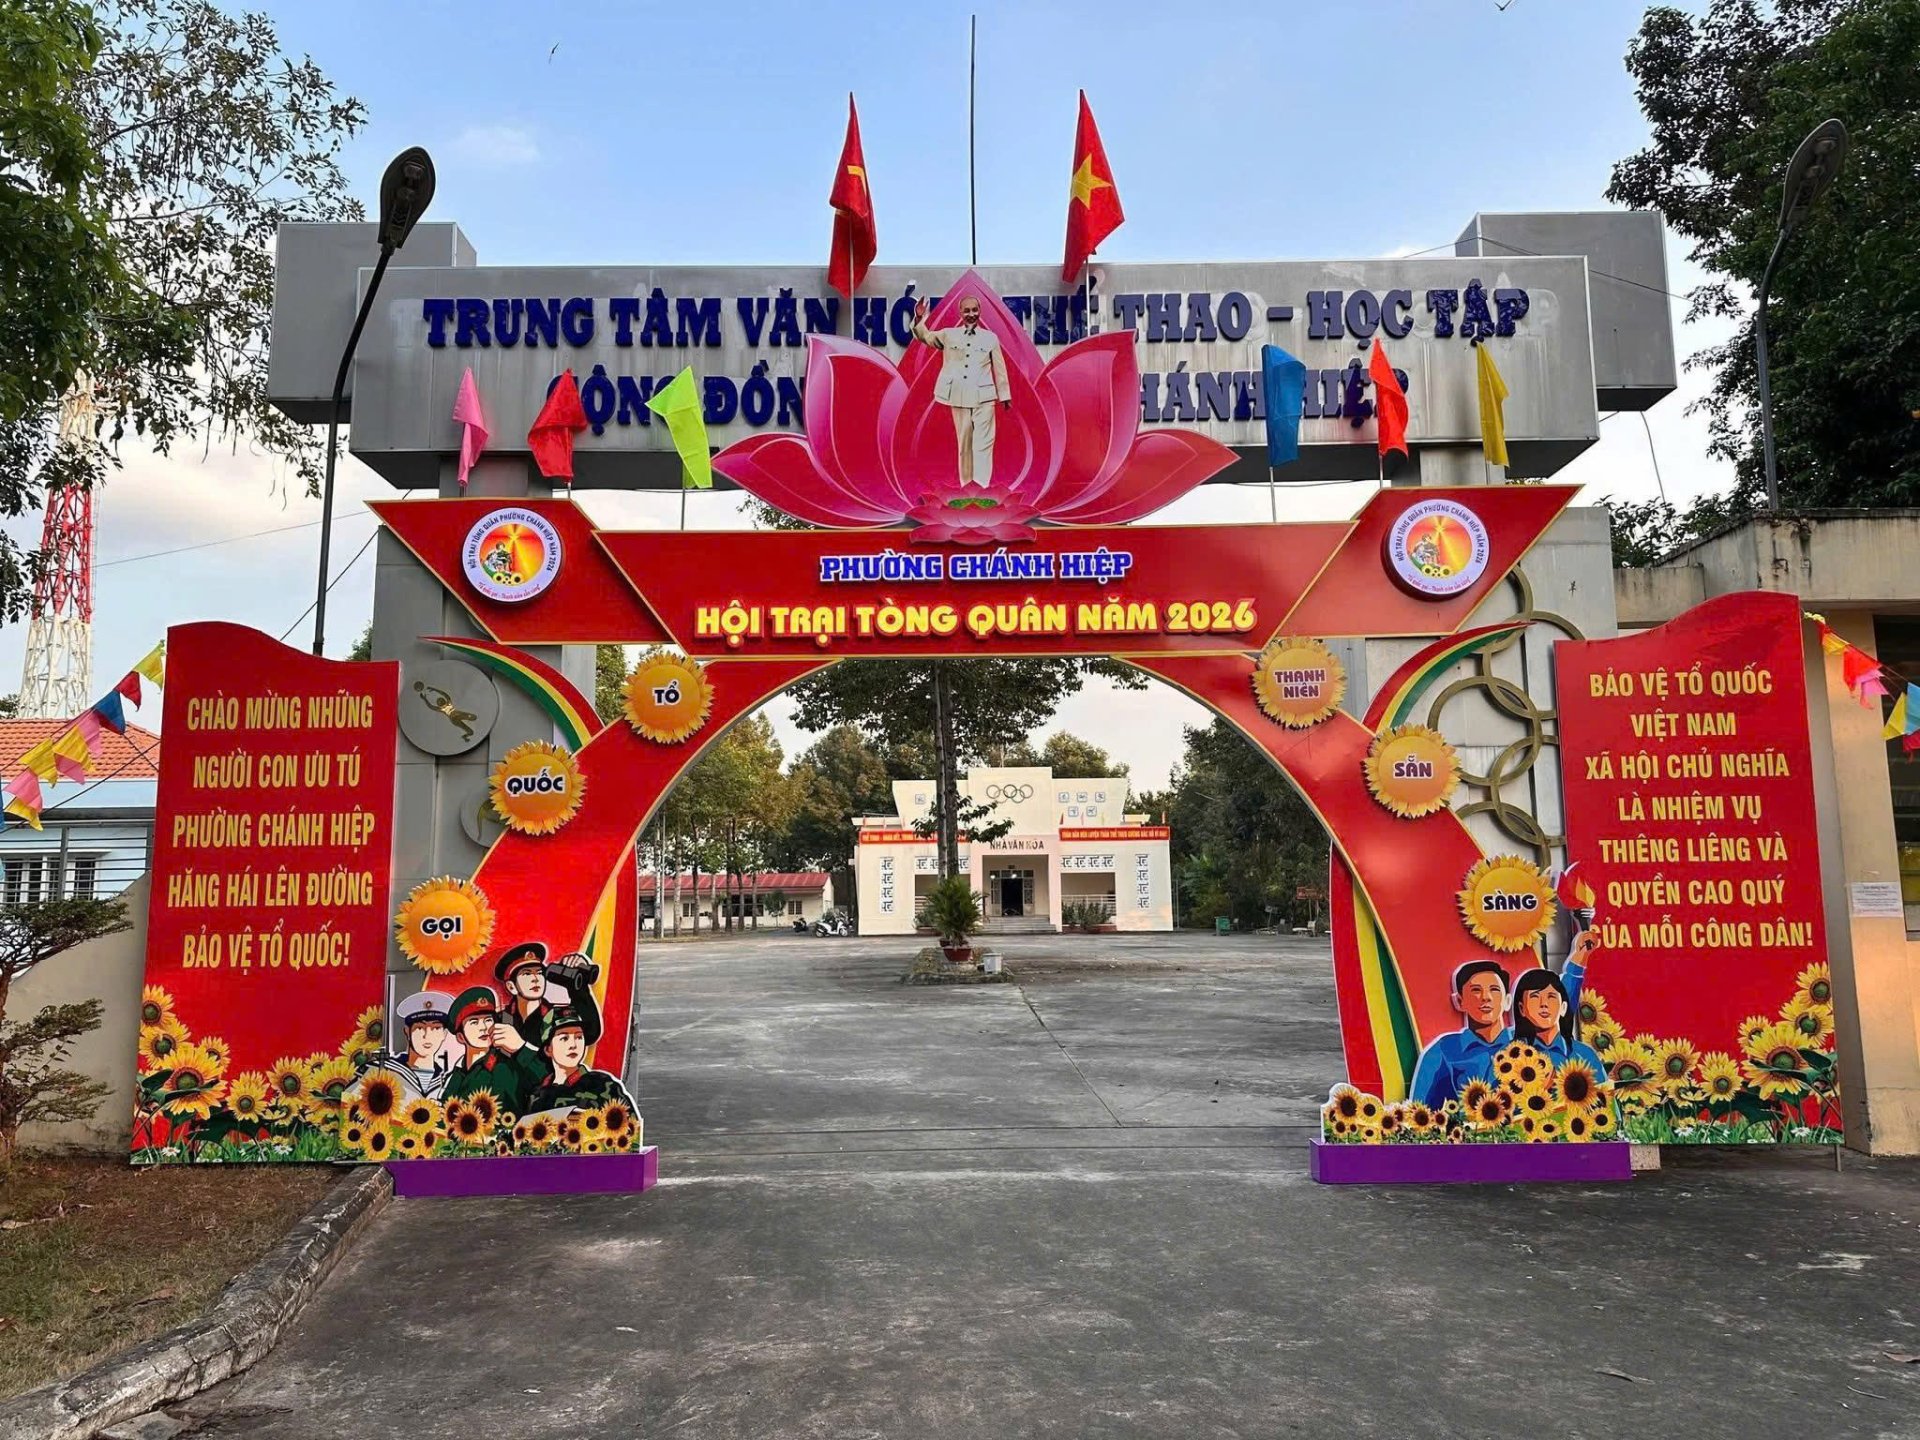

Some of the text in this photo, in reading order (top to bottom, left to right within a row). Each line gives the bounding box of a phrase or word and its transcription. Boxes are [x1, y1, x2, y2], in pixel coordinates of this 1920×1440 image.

[423, 297, 595, 348] TRUNG
[610, 287, 722, 348] TÂM
[737, 286, 839, 347] VĂN
[850, 283, 944, 347] HÓ
[1114, 290, 1252, 343] THAO
[1267, 306, 1294, 321] -
[1307, 288, 1414, 349] HỌC
[1427, 278, 1530, 348] TẬP
[704, 359, 806, 426] ĐỒN
[820, 547, 1133, 585] PHƯỜNG CHÁNH HIỆP
[696, 595, 1257, 646] HỘI TRẠI TÒNG QUÂN NĂM 2026
[653, 680, 681, 705] TỔ
[1274, 667, 1326, 684] THANH
[1283, 682, 1320, 699] NIÊN
[1590, 661, 1773, 701] BẢO VỆ TỔ QUỐC
[187, 688, 373, 731] CHÀO MỪNG NHỮNG
[1630, 708, 1737, 742] VIỆT NAM
[193, 746, 360, 788] NGƯỜI CON ƯU TÚ
[505, 769, 566, 797] QUỐC
[1585, 747, 1790, 784] XÃ HỘI CHỦ NGHĨA
[1618, 790, 1762, 825] LÀ NHIỆM VỤ
[172, 804, 375, 853] PHƯỜNG CHÁNH HIỆP
[1599, 832, 1788, 863] THIÊNG LIÊNG VÀ
[167, 864, 373, 908] HĂNG HÁI LÊN ĐƯỜNG
[1482, 885, 1537, 911] SÀNG
[1607, 872, 1785, 908] QUYỀN CAO QUÝ
[420, 916, 462, 940] GỌI
[1639, 915, 1683, 948] MỖI
[1691, 917, 1751, 948] CÔNG
[1759, 917, 1813, 947] DÂN!
[182, 918, 350, 975] BẢO VỆ TỔ QUỐC!
